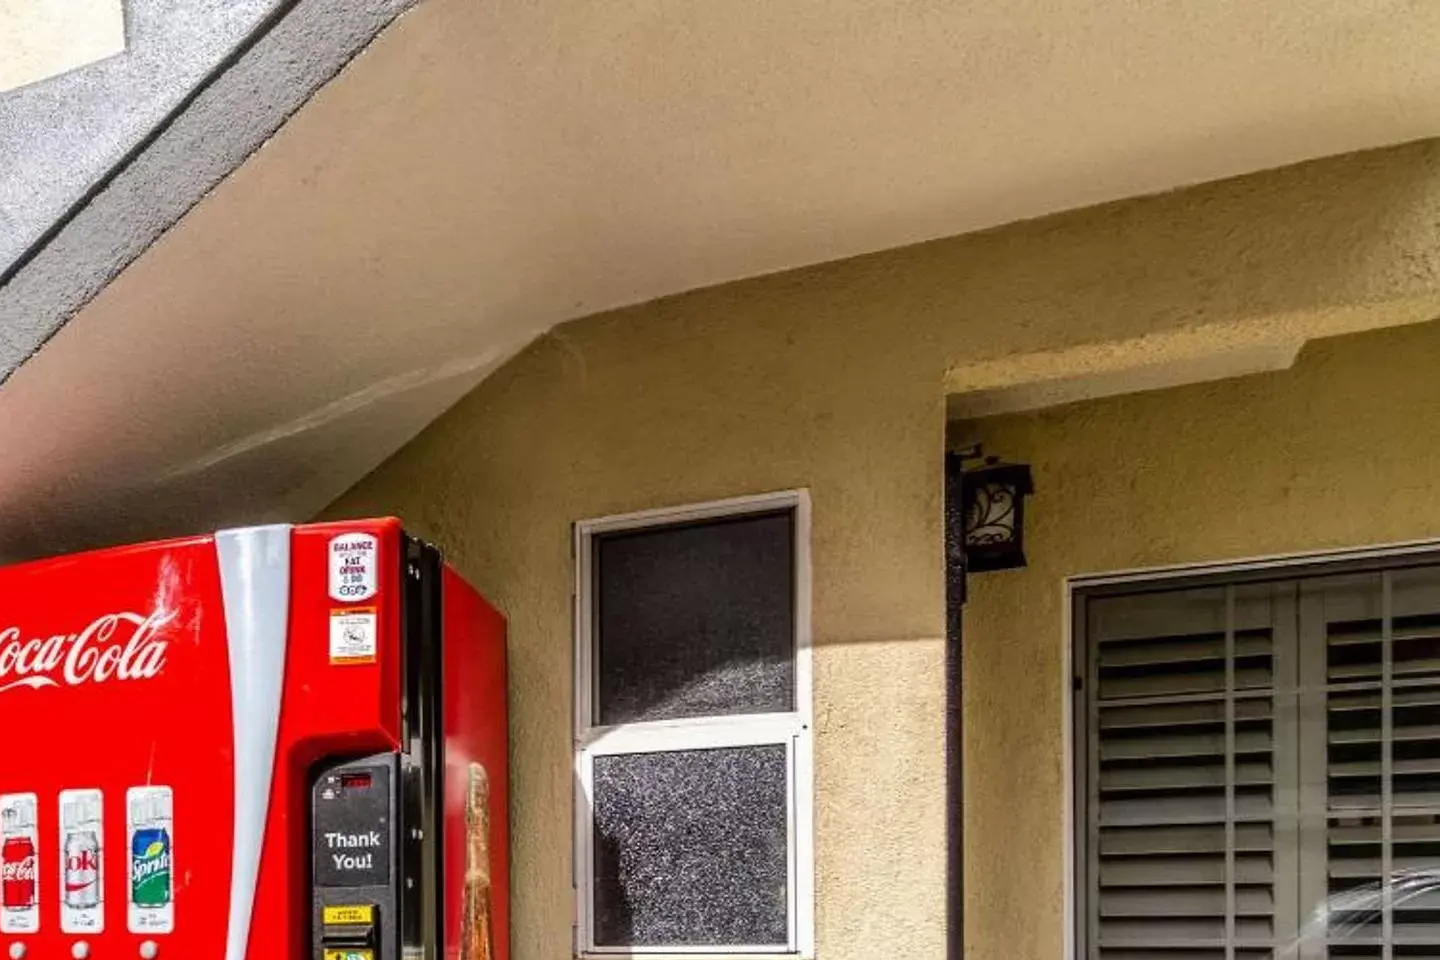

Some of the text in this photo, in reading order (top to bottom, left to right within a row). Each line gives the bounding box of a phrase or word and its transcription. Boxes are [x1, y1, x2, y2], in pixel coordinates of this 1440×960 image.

[333, 541, 373, 552] BALANCE
[323, 831, 381, 848] Thank
[332, 854, 372, 870] You!
